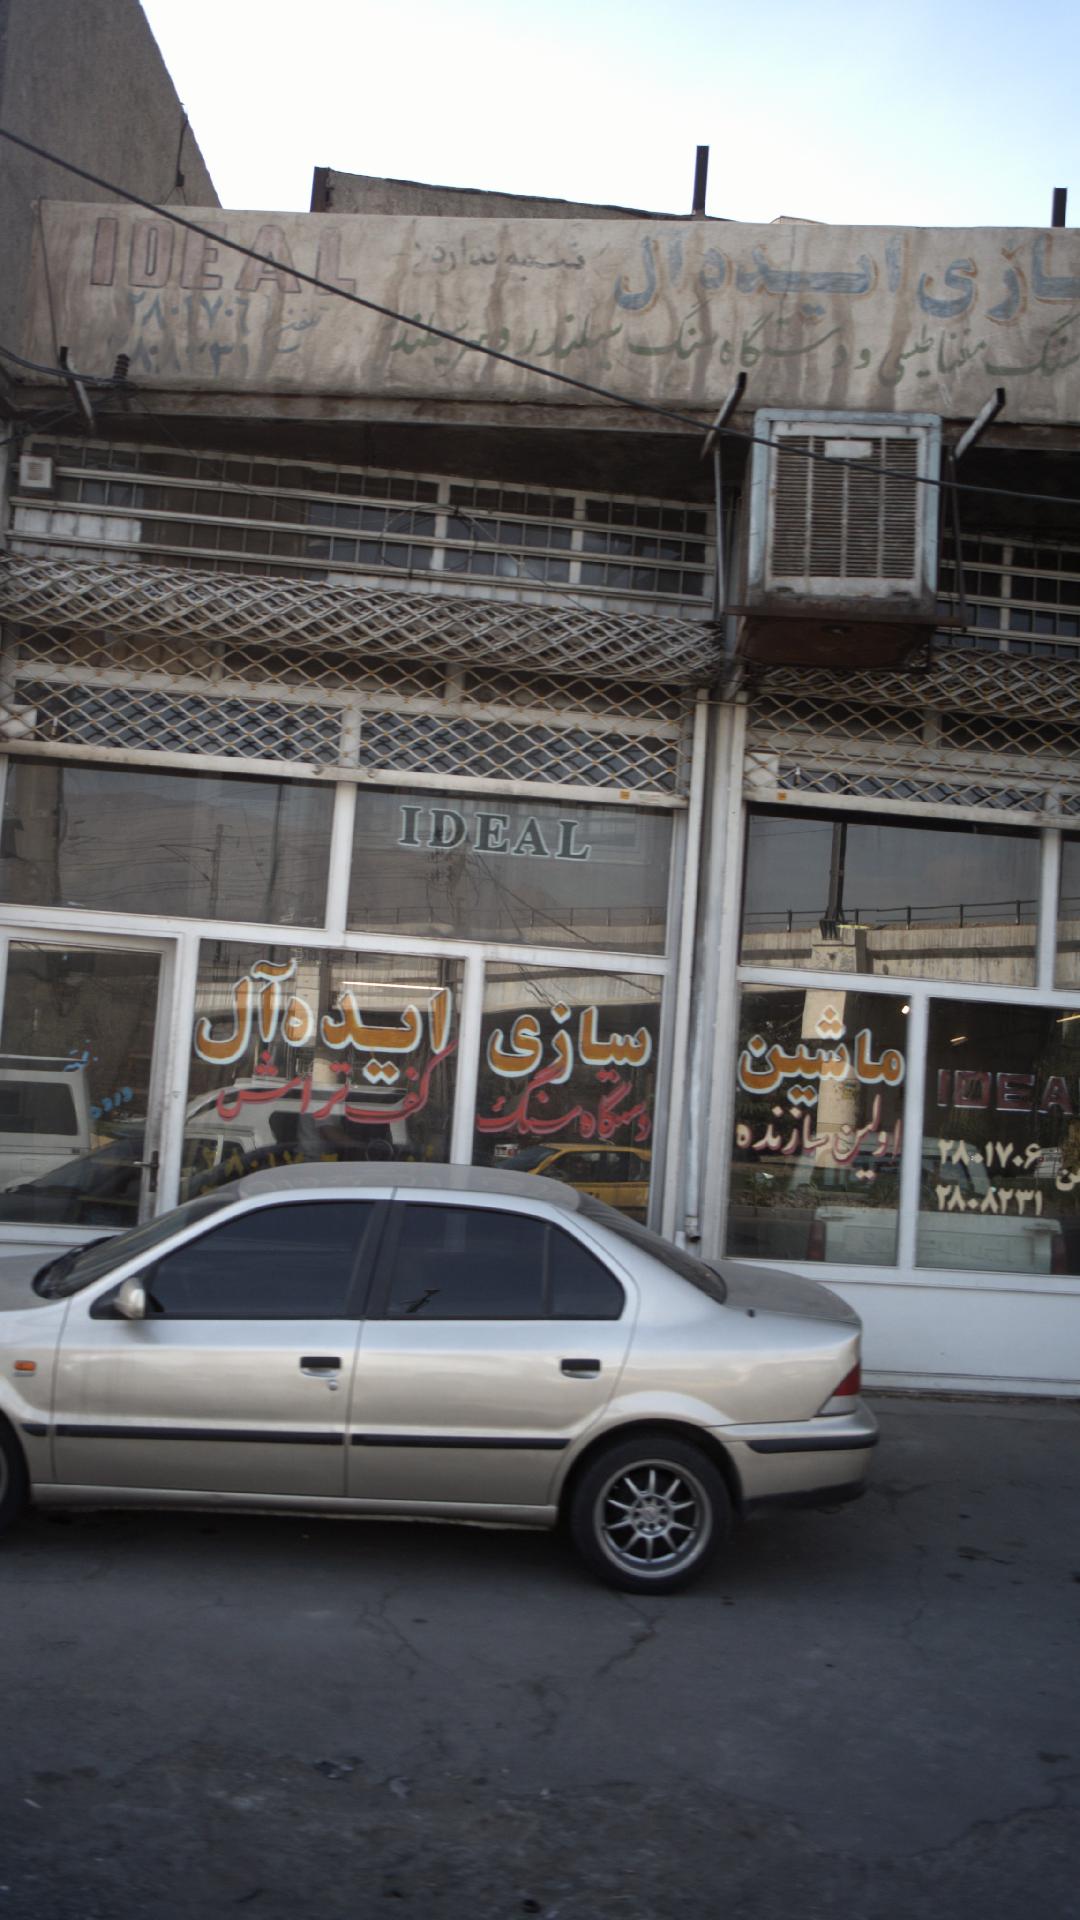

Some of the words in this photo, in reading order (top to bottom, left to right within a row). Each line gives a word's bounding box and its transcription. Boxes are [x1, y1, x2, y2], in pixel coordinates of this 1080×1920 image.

[90, 217, 356, 296] IDEAL
[918, 233, 1080, 326] ازی
[398, 806, 592, 861] IDEAL
[195, 957, 297, 1065] آل
[282, 986, 452, 1085] ایده
[487, 1001, 651, 1084] سازی
[738, 1005, 905, 1107] ماشین
[937, 1068, 1080, 1115] IDEA
